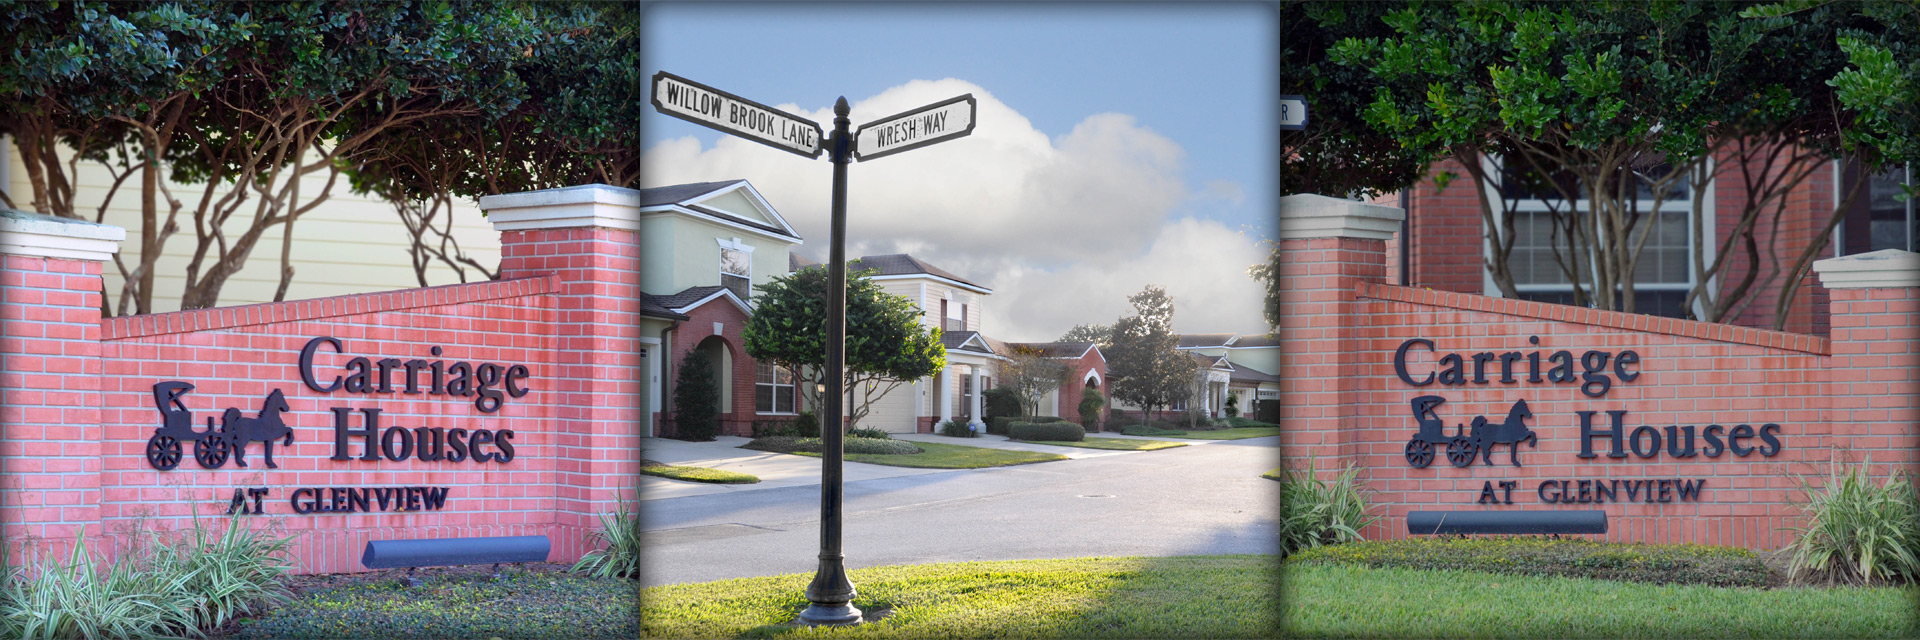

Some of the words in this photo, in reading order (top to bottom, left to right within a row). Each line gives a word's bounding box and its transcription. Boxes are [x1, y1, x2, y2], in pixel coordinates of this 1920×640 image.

[667, 82, 722, 119] WILLOW
[730, 103, 775, 136] BROOK
[782, 120, 813, 148] LANE
[877, 119, 917, 148] WRESH
[923, 110, 948, 136] WAY
[299, 336, 530, 413] Carriage
[1394, 335, 1641, 398] Carriage
[329, 406, 515, 463] Houses
[1575, 410, 1782, 459] Houses
[226, 487, 269, 515] AT
[290, 486, 451, 515] GLENVIEW
[1477, 480, 1517, 505] AT
[1537, 478, 1707, 504] GLENVIEW
